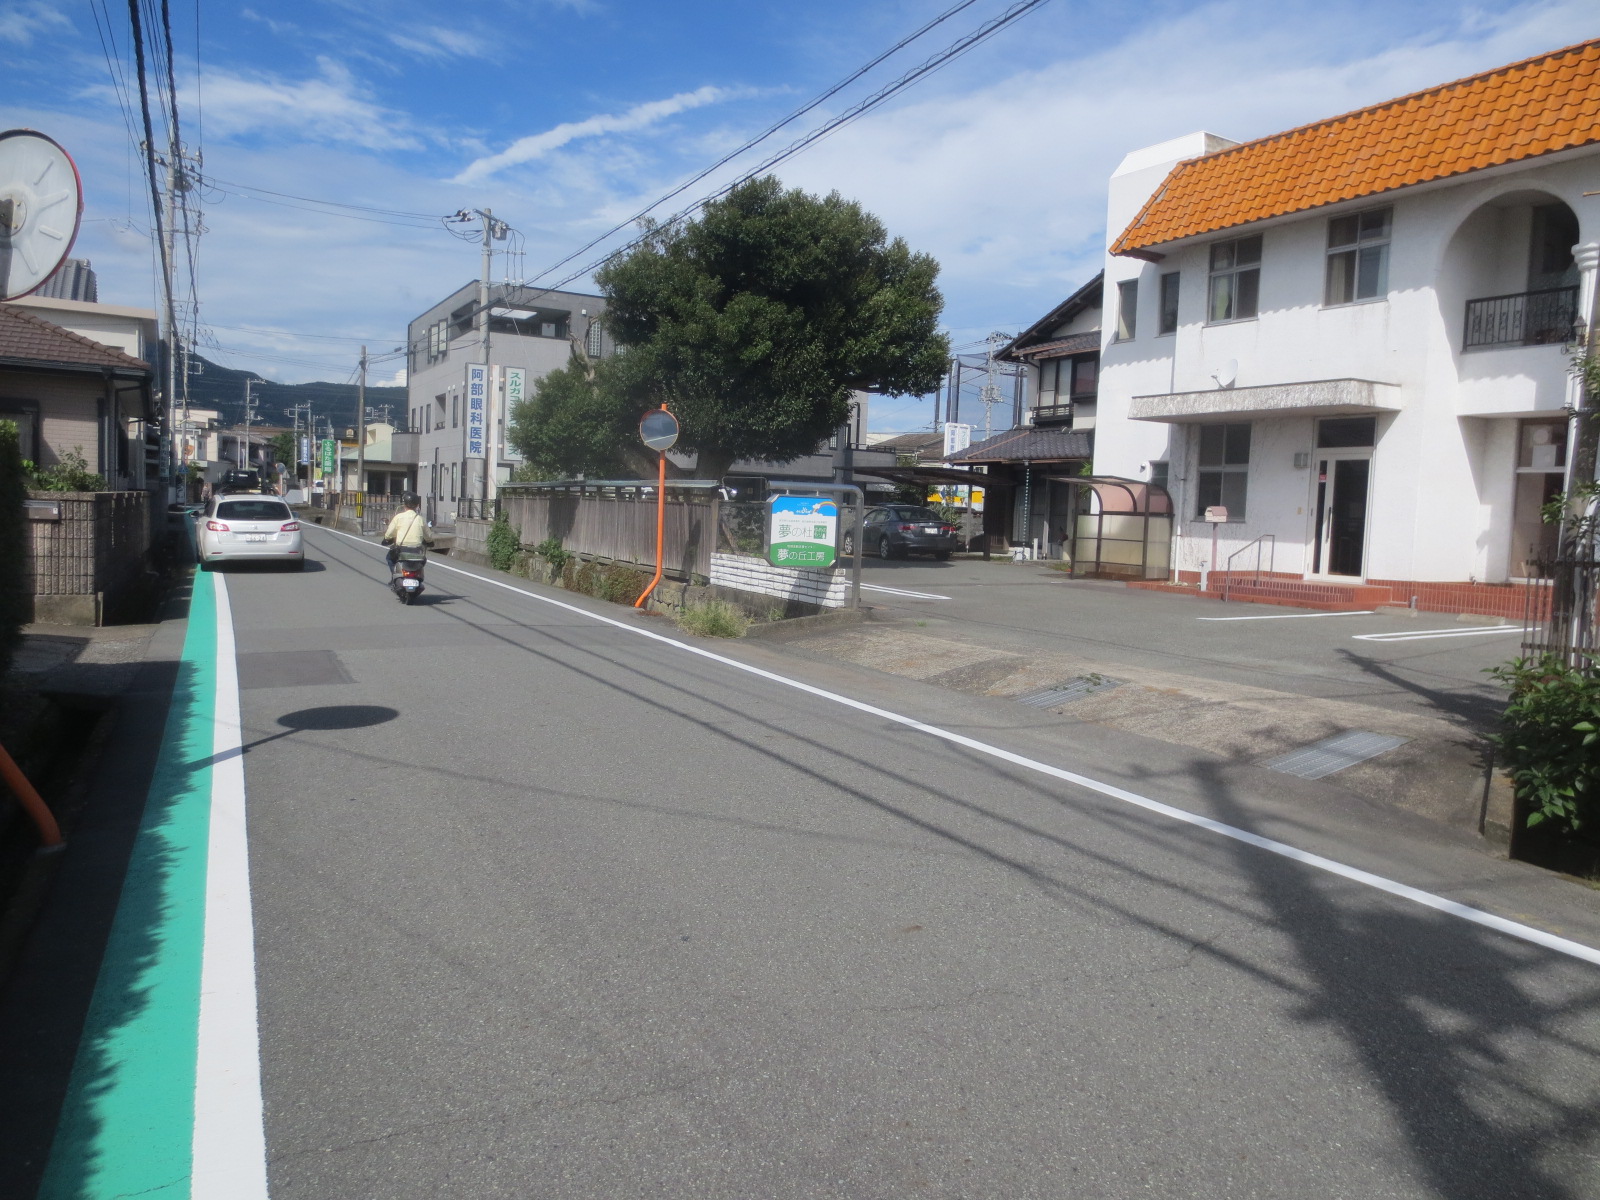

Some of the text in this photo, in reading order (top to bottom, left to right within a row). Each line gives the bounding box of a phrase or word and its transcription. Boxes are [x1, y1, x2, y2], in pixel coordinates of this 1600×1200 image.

[469, 368, 484, 454] 阿部眼科医院
[778, 524, 812, 538] 夢の杜
[777, 548, 825, 562] 夢の丘工房
